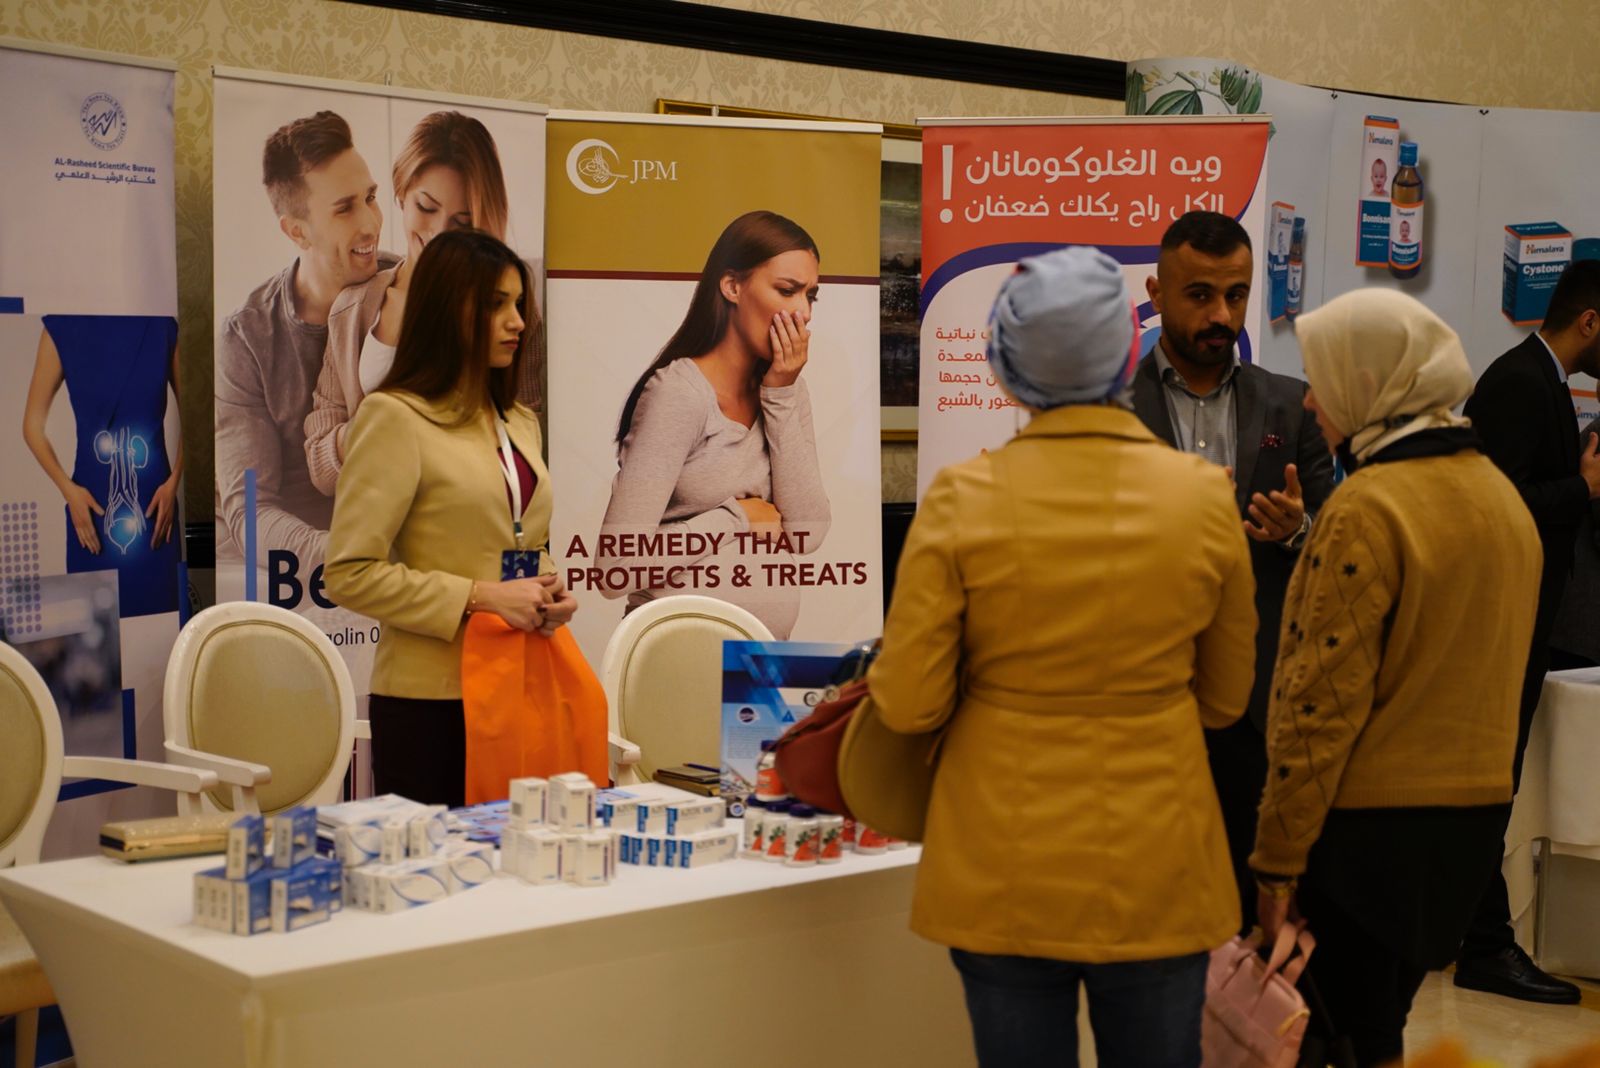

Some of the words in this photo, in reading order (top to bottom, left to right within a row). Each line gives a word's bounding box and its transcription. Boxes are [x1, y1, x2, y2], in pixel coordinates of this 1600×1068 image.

[55, 157, 97, 169] AL-Rasheed
[98, 160, 131, 171] Scientific
[132, 164, 156, 173] Bureau
[629, 159, 678, 185] JPM
[965, 146, 1157, 184] الغلوكومانان
[1169, 155, 1223, 182] ويه
[964, 194, 1050, 224] ضعفان
[1059, 191, 1119, 222] يكلك
[1128, 194, 1160, 228] راح
[1522, 264, 1564, 277] Cystone
[935, 327, 976, 342] نباتية
[939, 371, 982, 386] حجمها
[937, 391, 983, 412] بالشبع
[565, 534, 589, 559] A
[600, 532, 726, 557] REMEDY
[733, 531, 810, 555] THAT
[566, 564, 721, 592] PROTECTS
[731, 564, 752, 588] &
[761, 562, 868, 587] TREATS
[325, 627, 365, 646] olin
